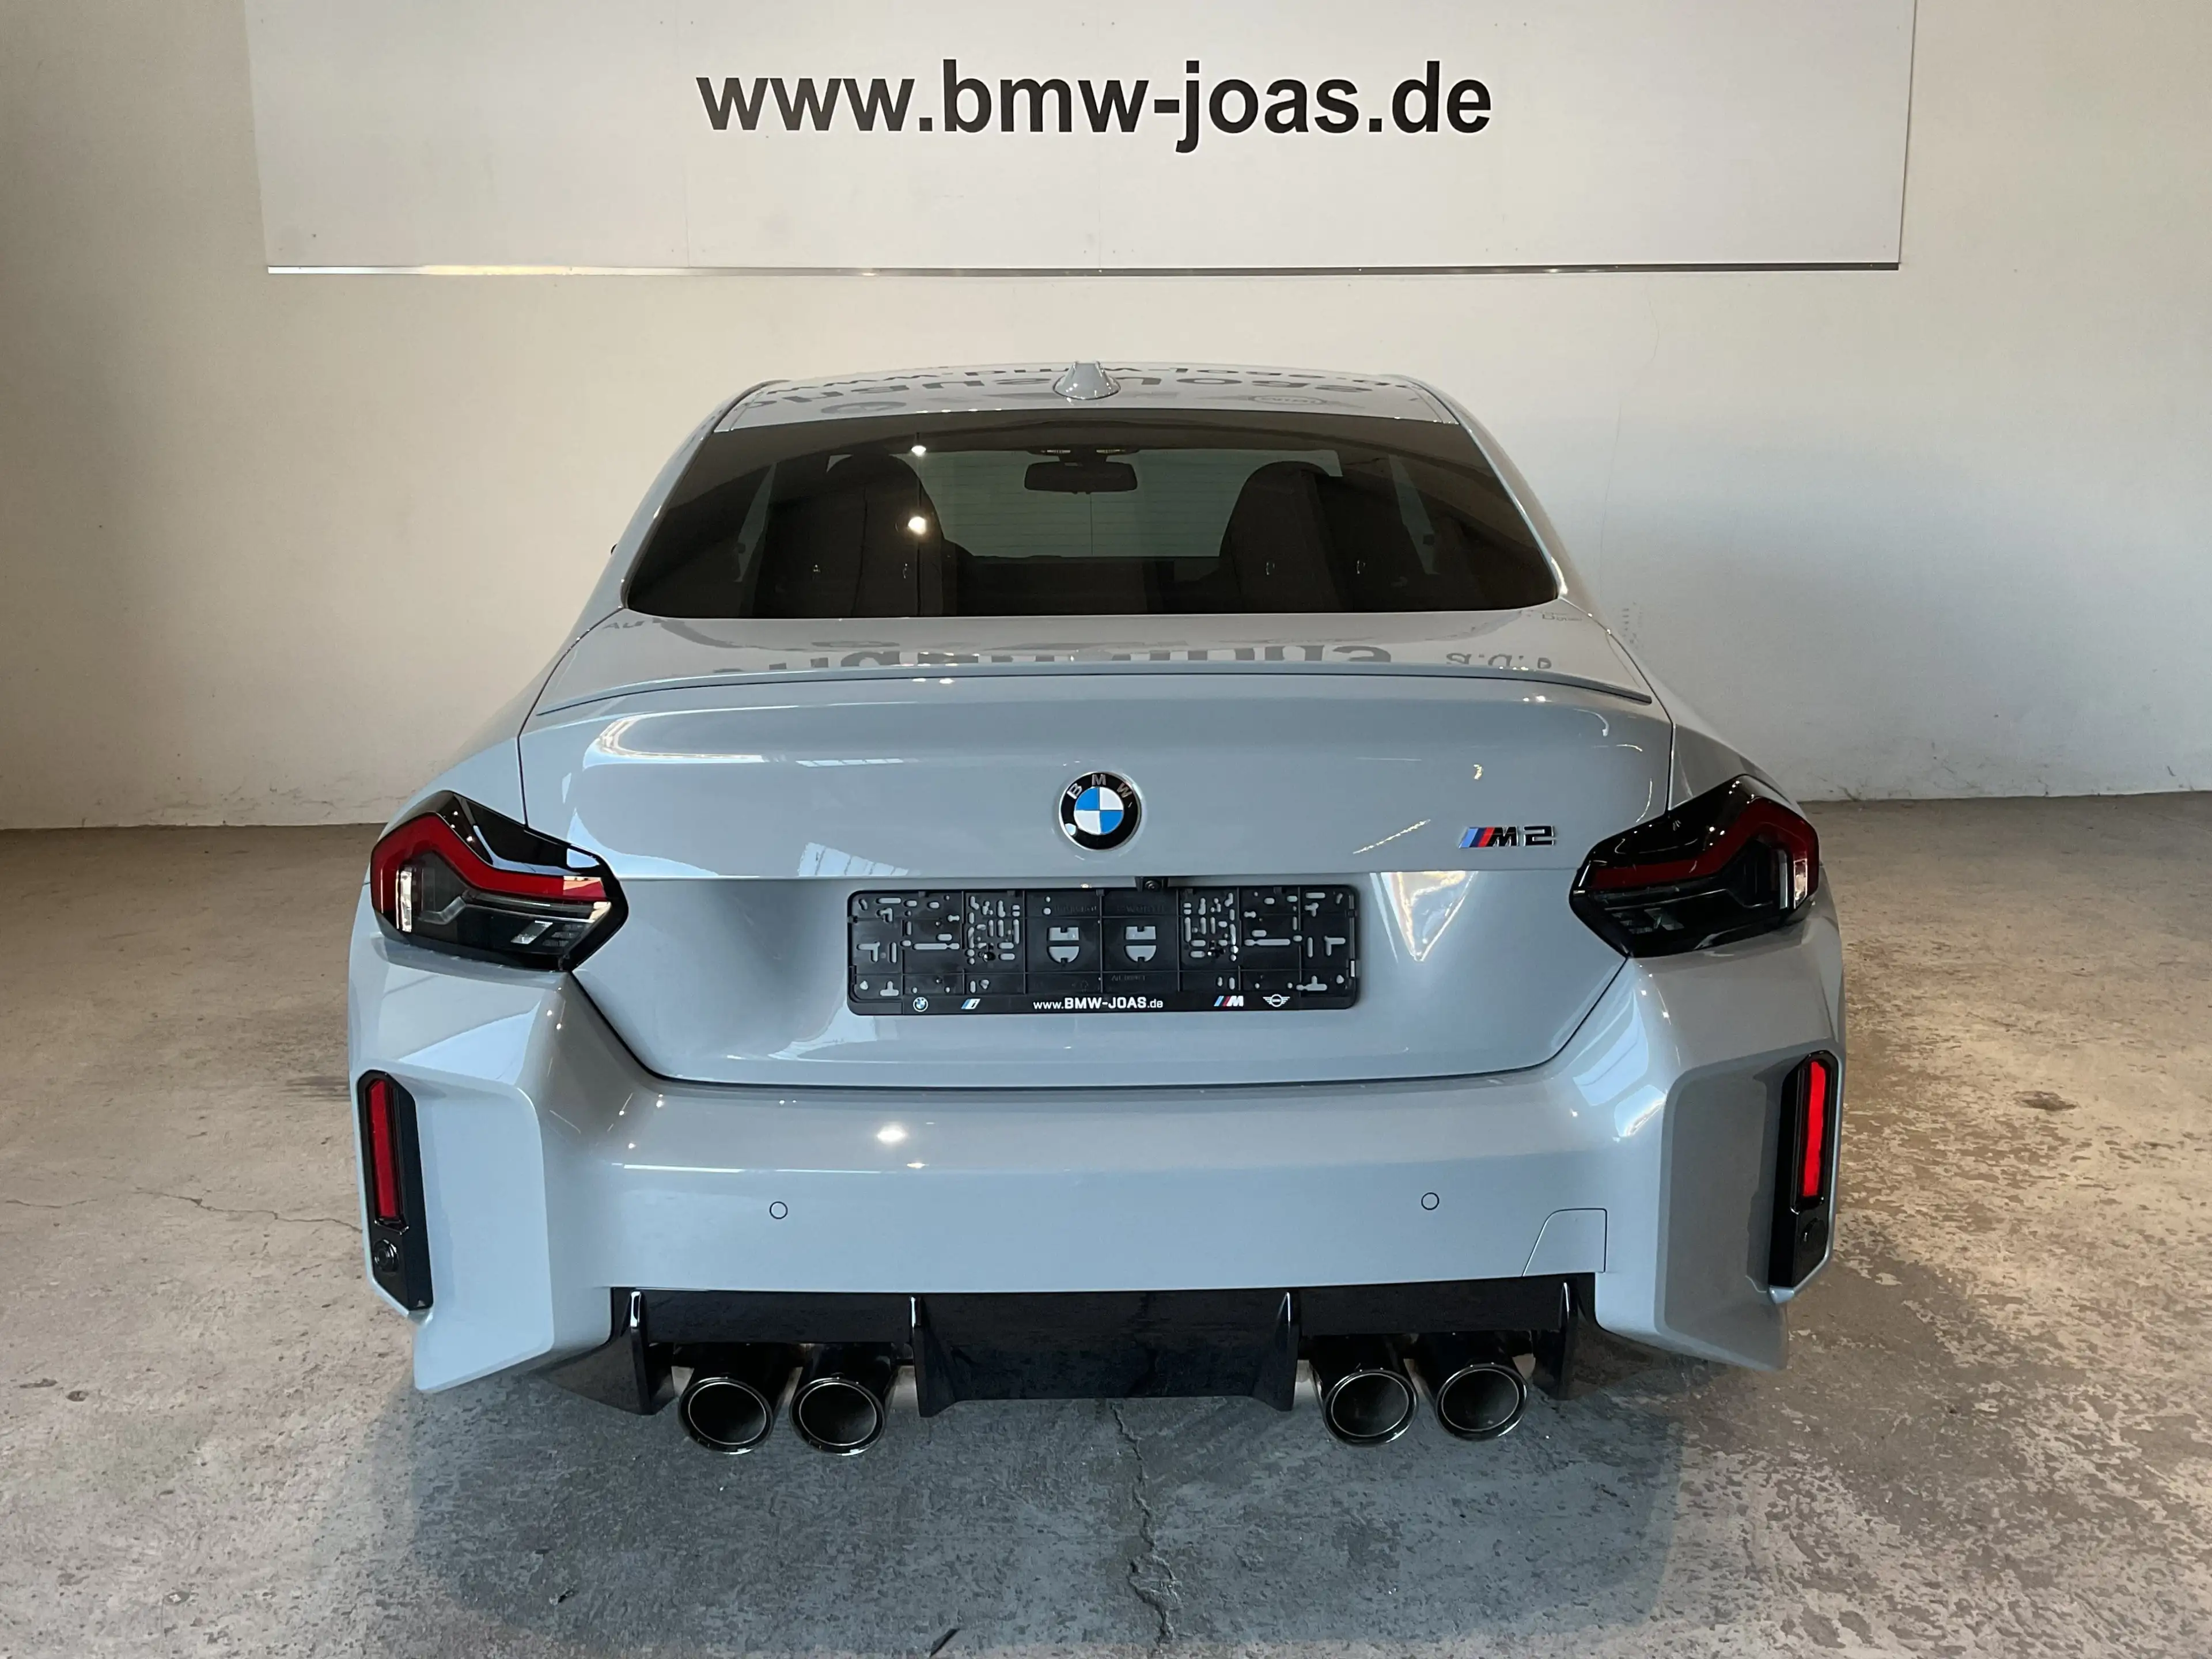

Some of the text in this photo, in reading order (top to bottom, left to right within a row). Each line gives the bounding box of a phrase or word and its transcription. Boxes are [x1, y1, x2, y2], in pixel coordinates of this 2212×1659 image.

[696, 58, 1491, 153] www.bmw-joas.de
[1067, 774, 1132, 800] BMW
[1033, 997, 1164, 1009] www.BMW-JOAS.de
